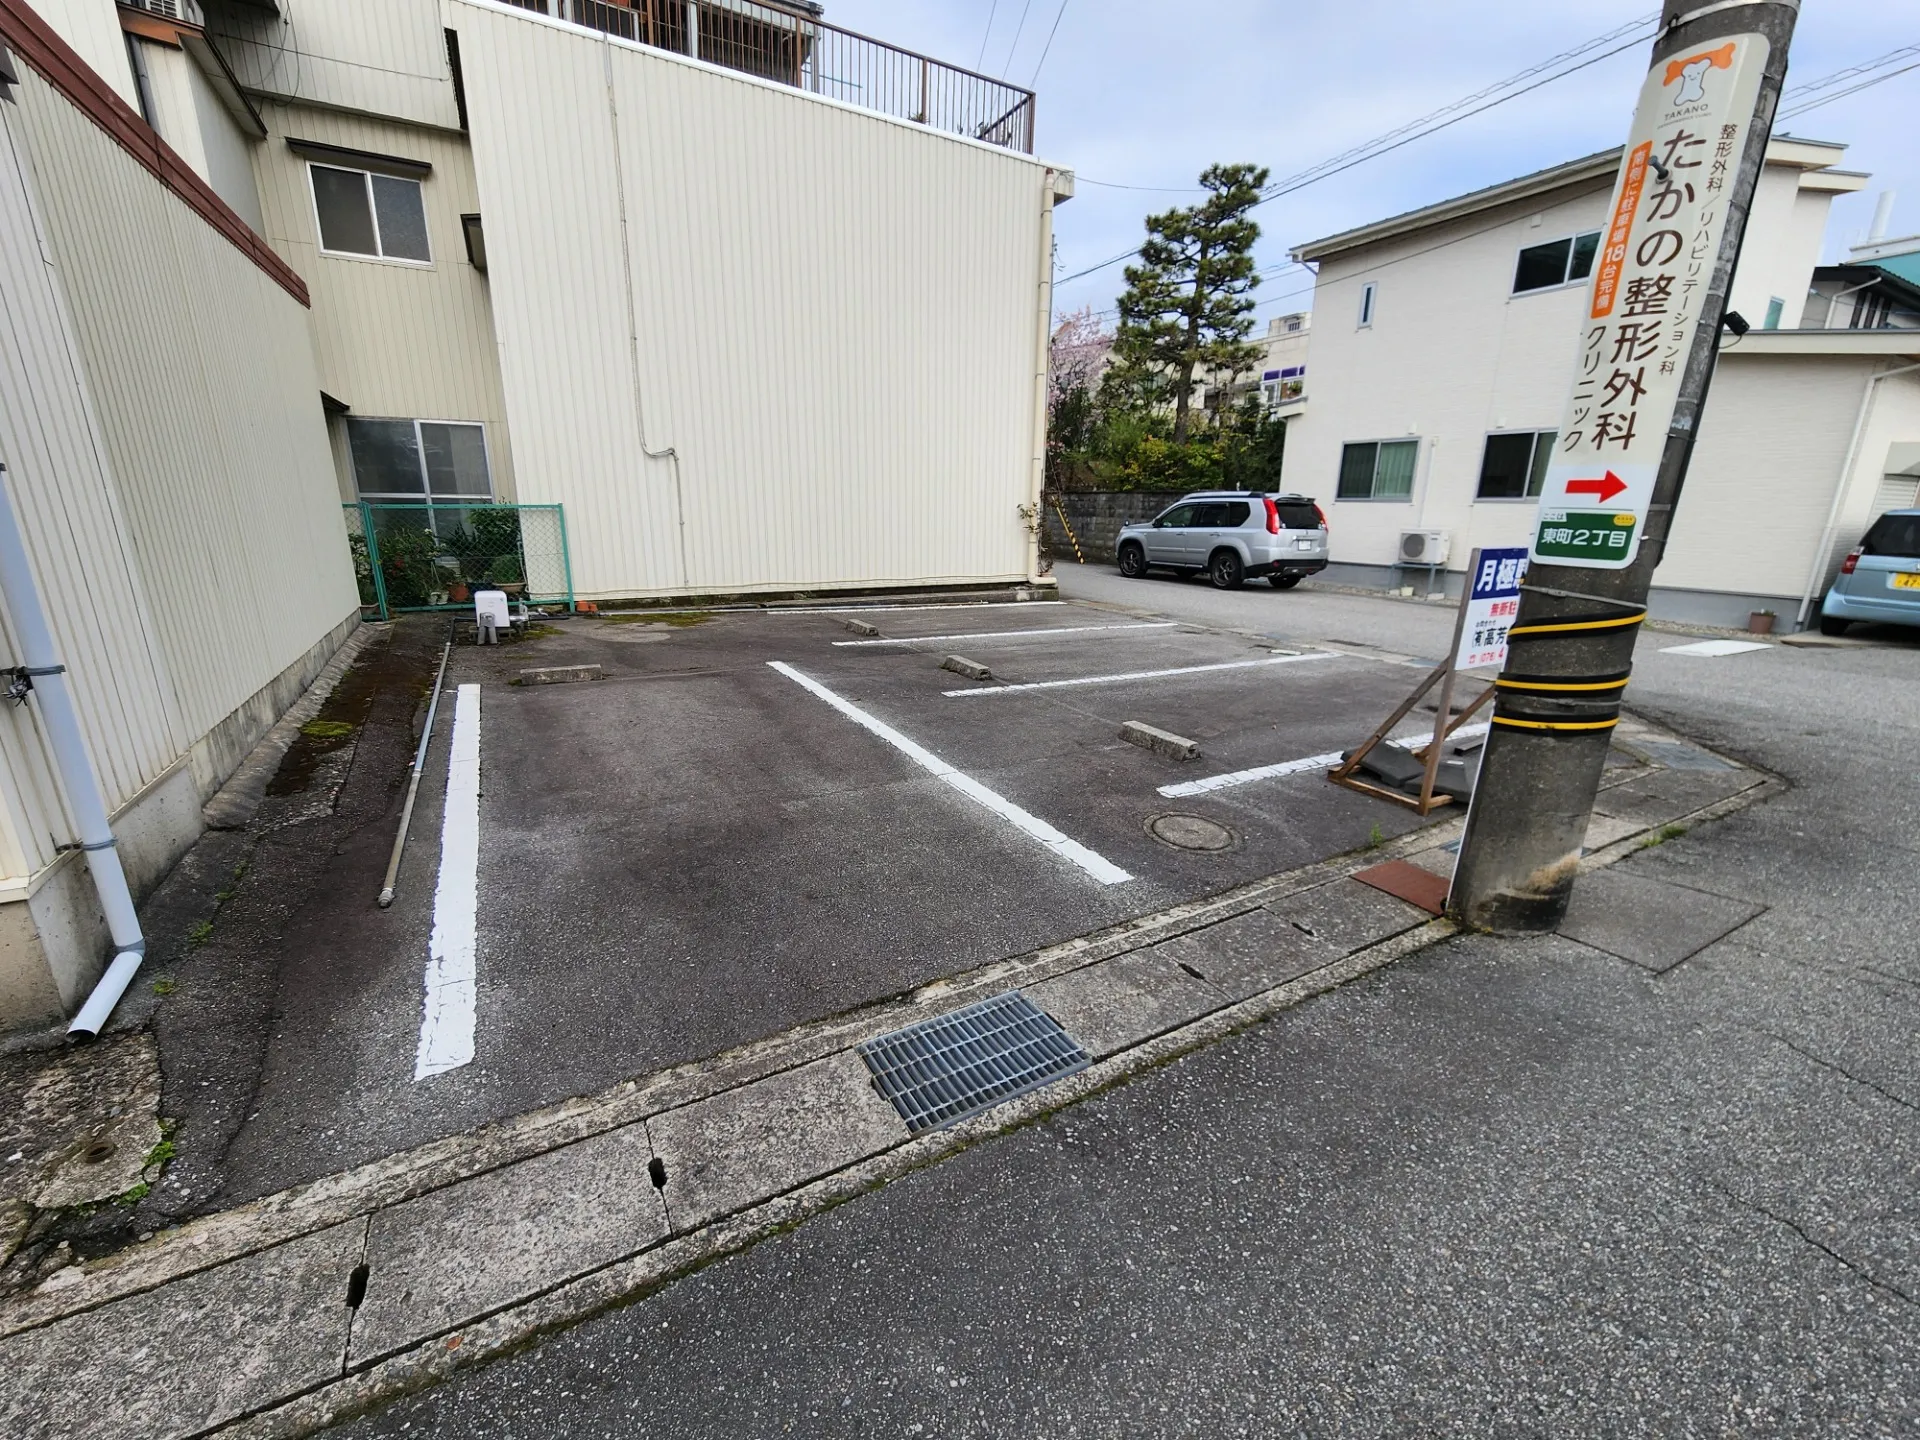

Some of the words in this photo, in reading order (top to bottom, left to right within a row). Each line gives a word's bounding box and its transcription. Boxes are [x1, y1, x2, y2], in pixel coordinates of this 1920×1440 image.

[1664, 103, 1709, 120] TAKANO
[1591, 129, 1706, 450] たかの整形外科
[1564, 325, 1606, 452] クリニック
